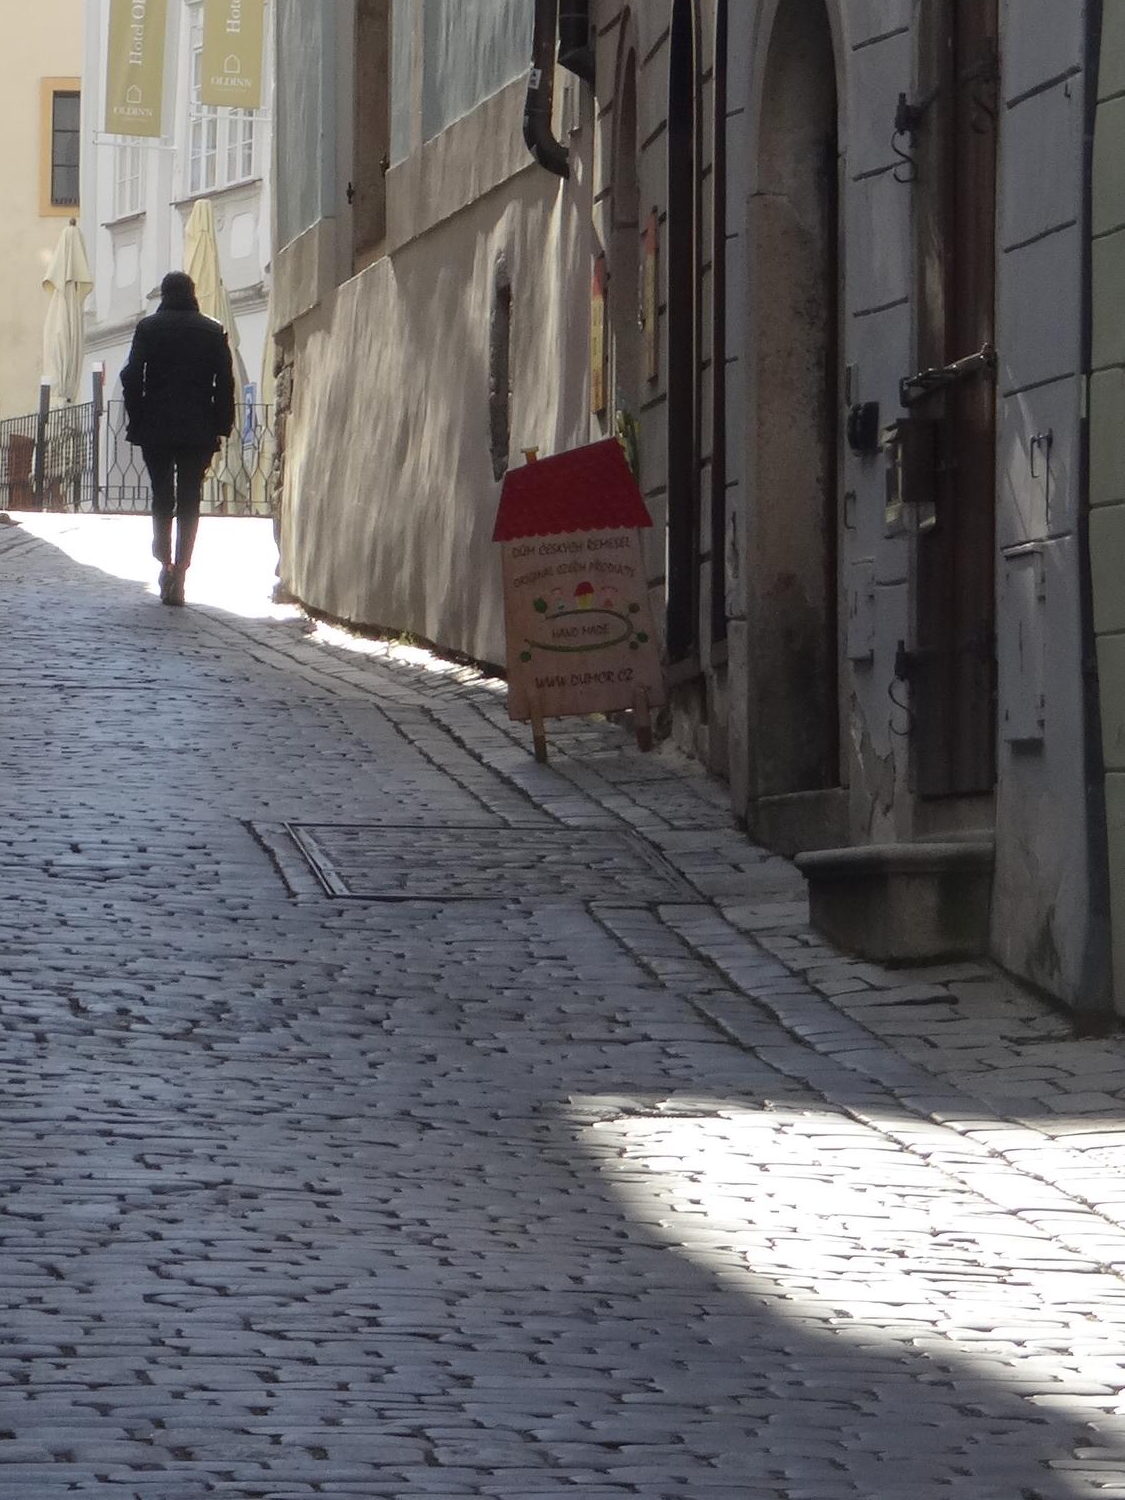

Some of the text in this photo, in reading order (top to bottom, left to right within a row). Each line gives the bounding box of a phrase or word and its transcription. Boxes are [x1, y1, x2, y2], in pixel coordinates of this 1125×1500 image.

[129, 24, 144, 65] Hotel
[551, 621, 610, 639] HAND MADE
